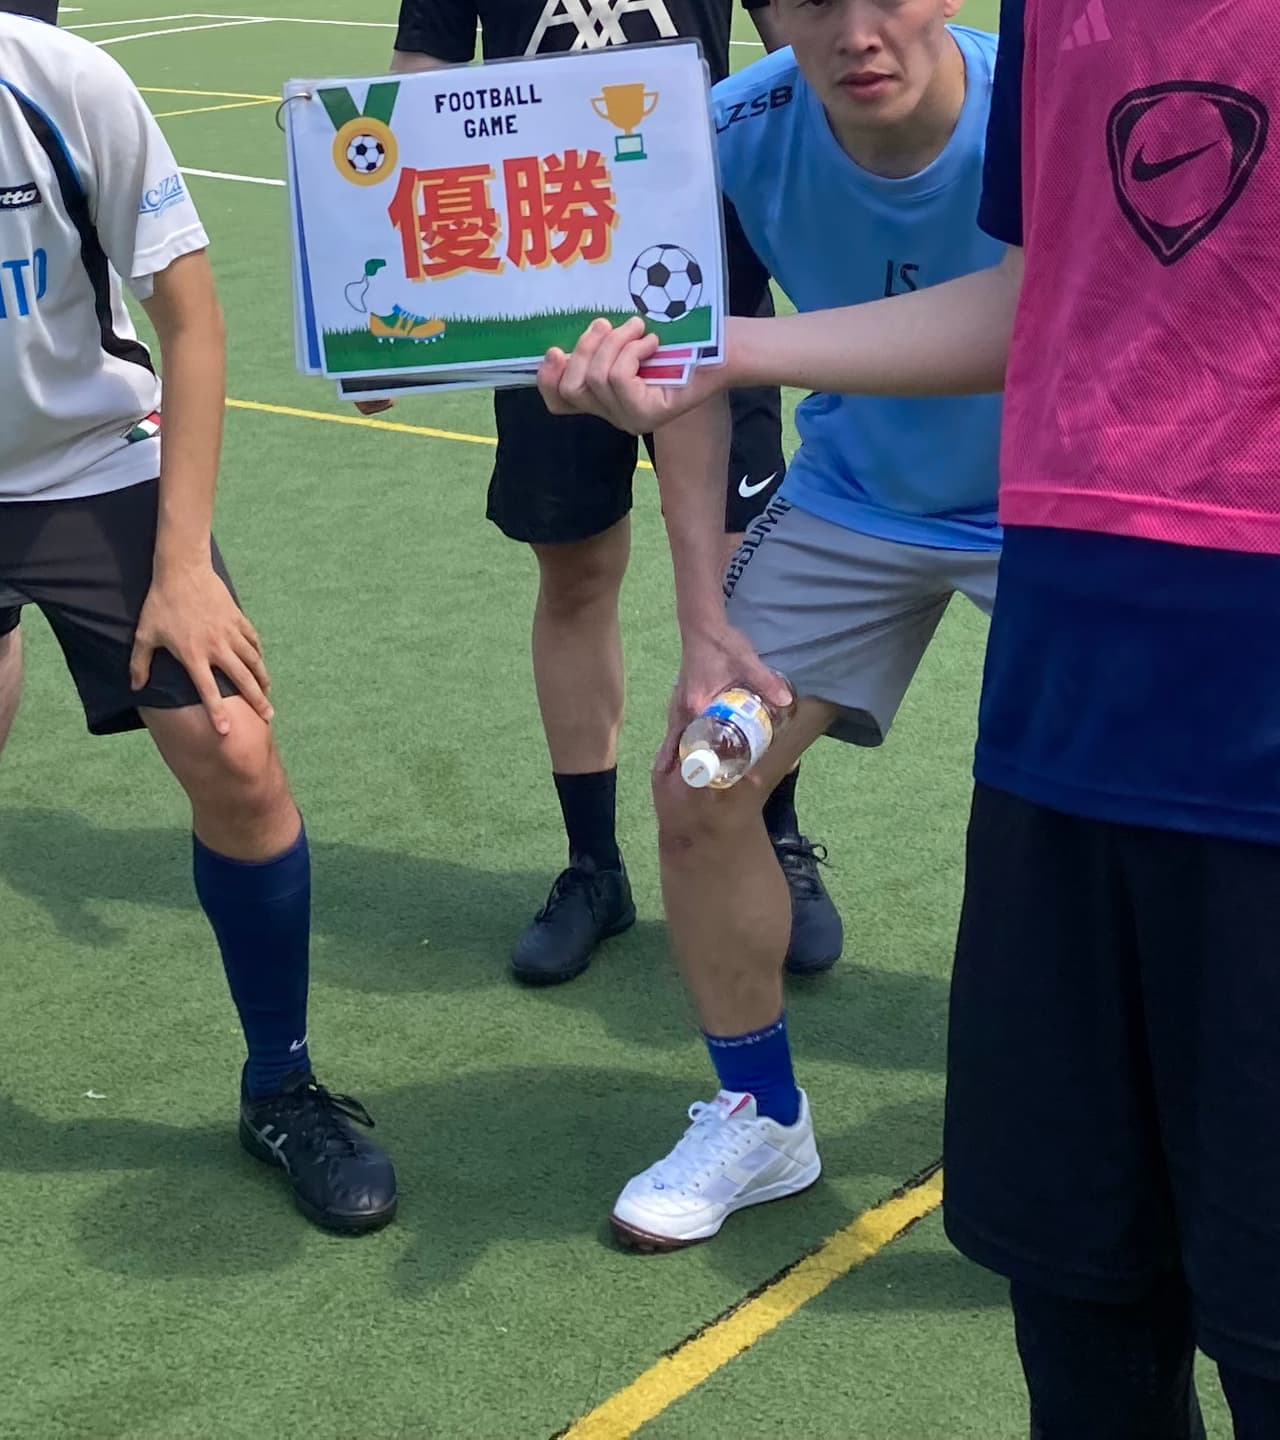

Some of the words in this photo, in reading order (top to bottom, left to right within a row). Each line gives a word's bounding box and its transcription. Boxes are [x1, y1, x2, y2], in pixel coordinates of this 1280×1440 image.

[434, 84, 543, 113] FOOTBALL
[464, 114, 518, 139] GAME
[388, 148, 621, 283] 優勝
